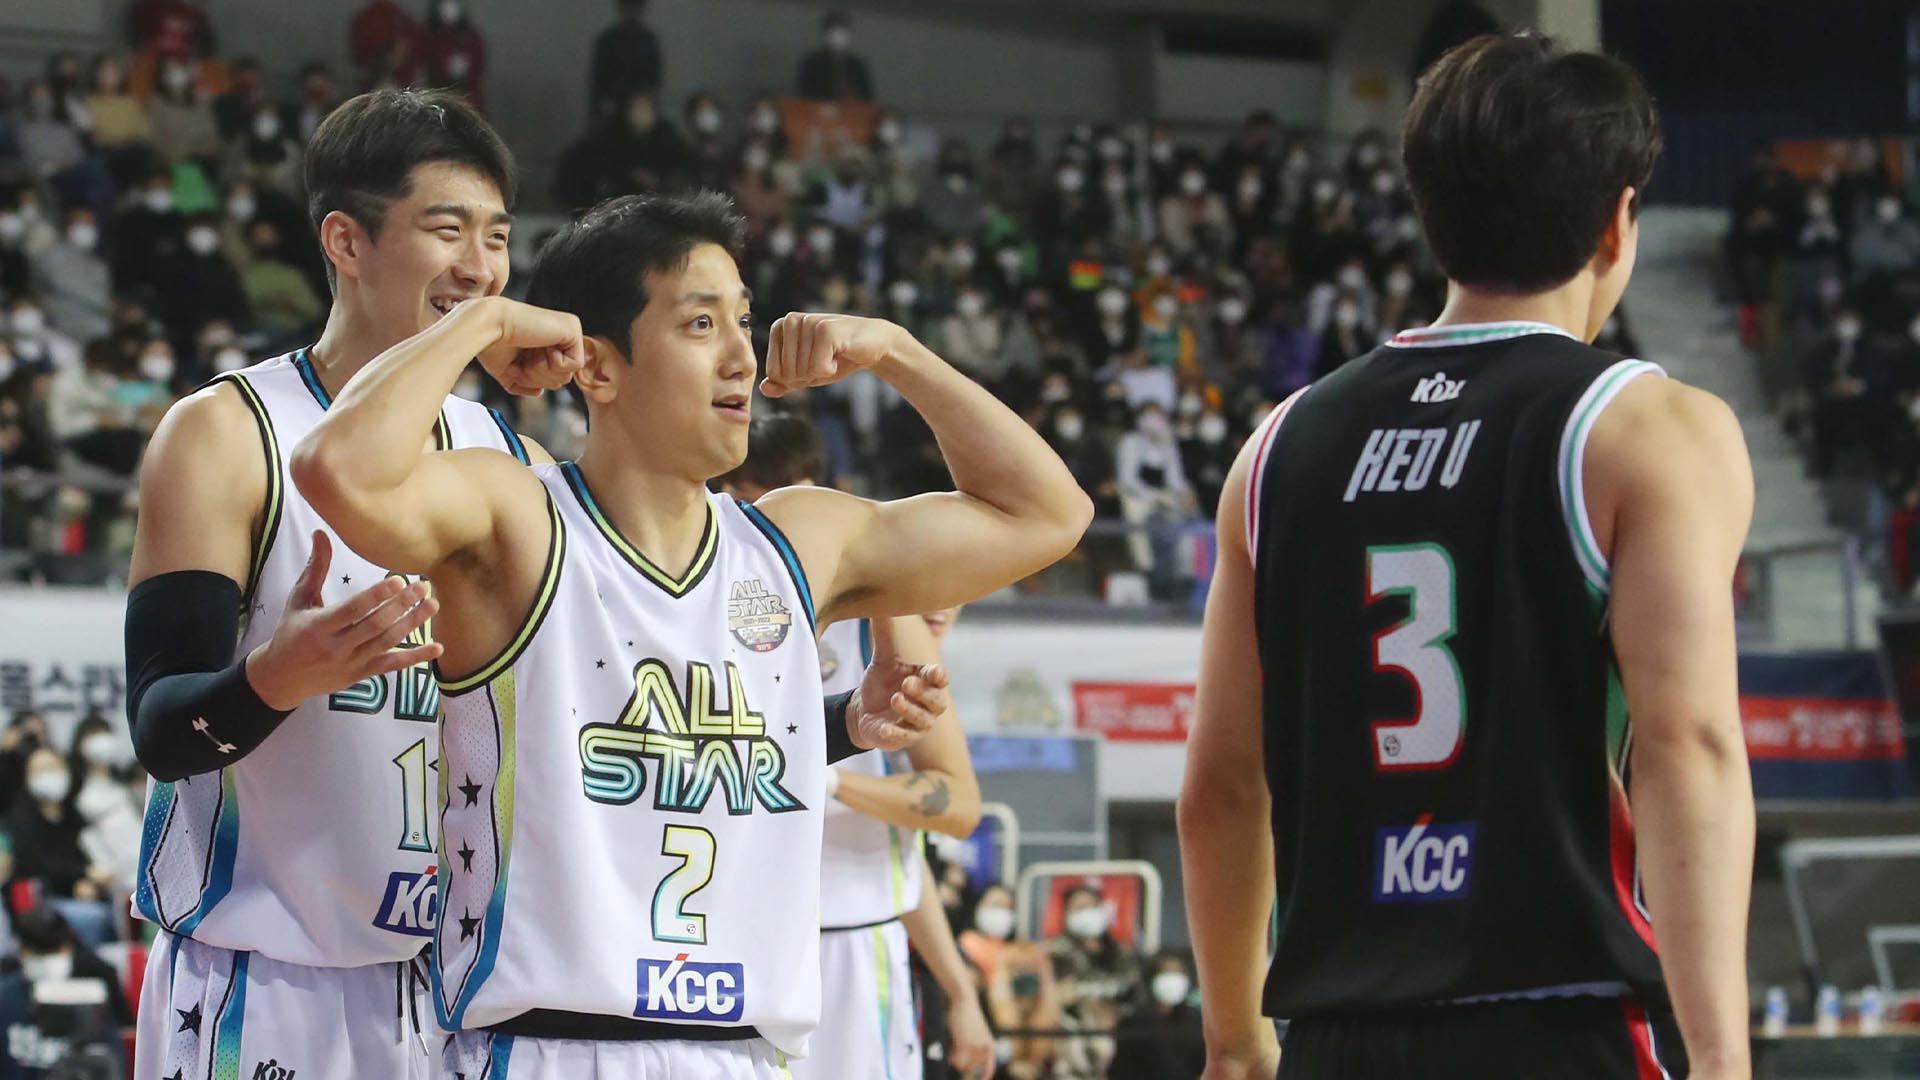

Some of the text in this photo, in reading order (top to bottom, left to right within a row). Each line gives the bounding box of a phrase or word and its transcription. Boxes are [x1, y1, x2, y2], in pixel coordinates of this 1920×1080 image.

[1439, 418, 1482, 490] U
[728, 595, 790, 617] STAR
[731, 579, 769, 600] ALL
[1364, 541, 1468, 772] 3
[616, 658, 765, 737] ALL
[392, 737, 439, 854] 1
[579, 722, 809, 816] STAR
[651, 823, 717, 946] 2
[1382, 812, 1469, 894] KCC
[386, 865, 438, 929] KC
[647, 953, 736, 1015] KCC
